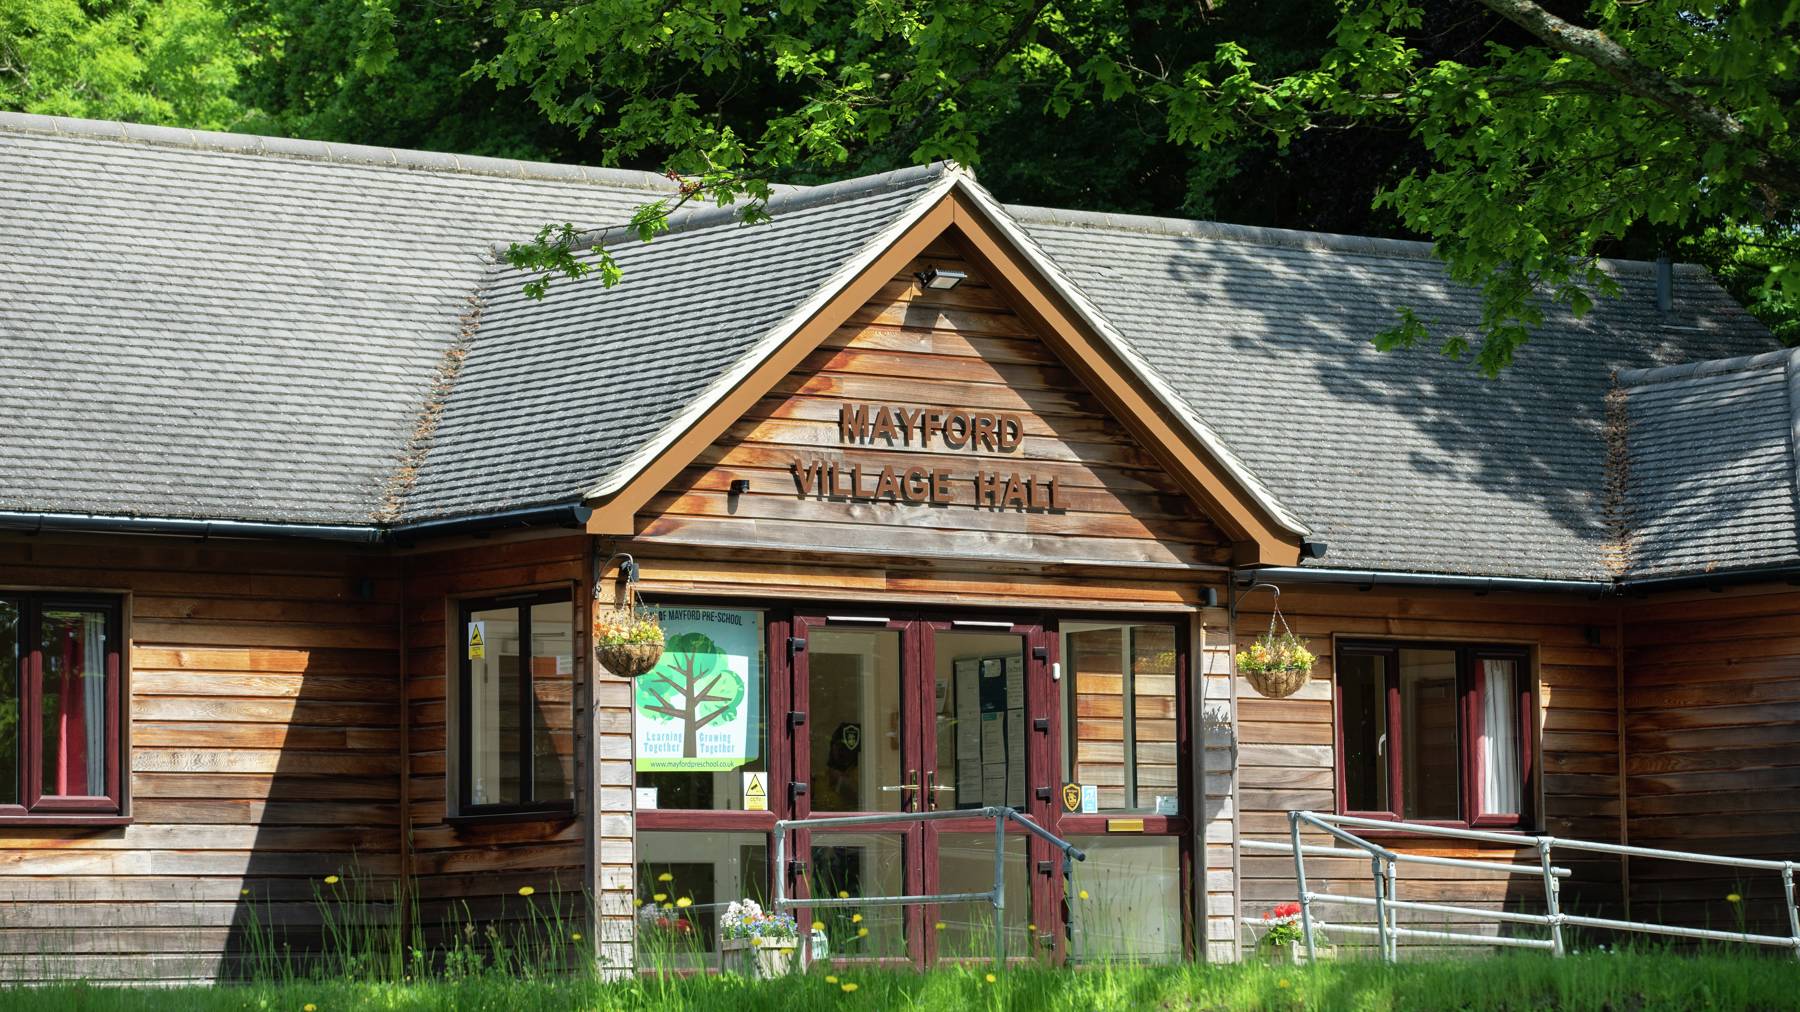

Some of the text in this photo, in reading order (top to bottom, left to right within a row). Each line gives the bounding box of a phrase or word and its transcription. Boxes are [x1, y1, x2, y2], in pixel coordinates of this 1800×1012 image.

[841, 402, 1024, 448] MAYFORD
[793, 458, 1071, 509] VILLAGE HALL
[658, 610, 667, 621] OF
[668, 610, 701, 621] MAYFORD
[702, 611, 743, 626] PRE-SCHOOL
[646, 731, 682, 743] Learning
[699, 732, 731, 744] Growing
[643, 742, 680, 754] Together
[700, 744, 735, 754] Together
